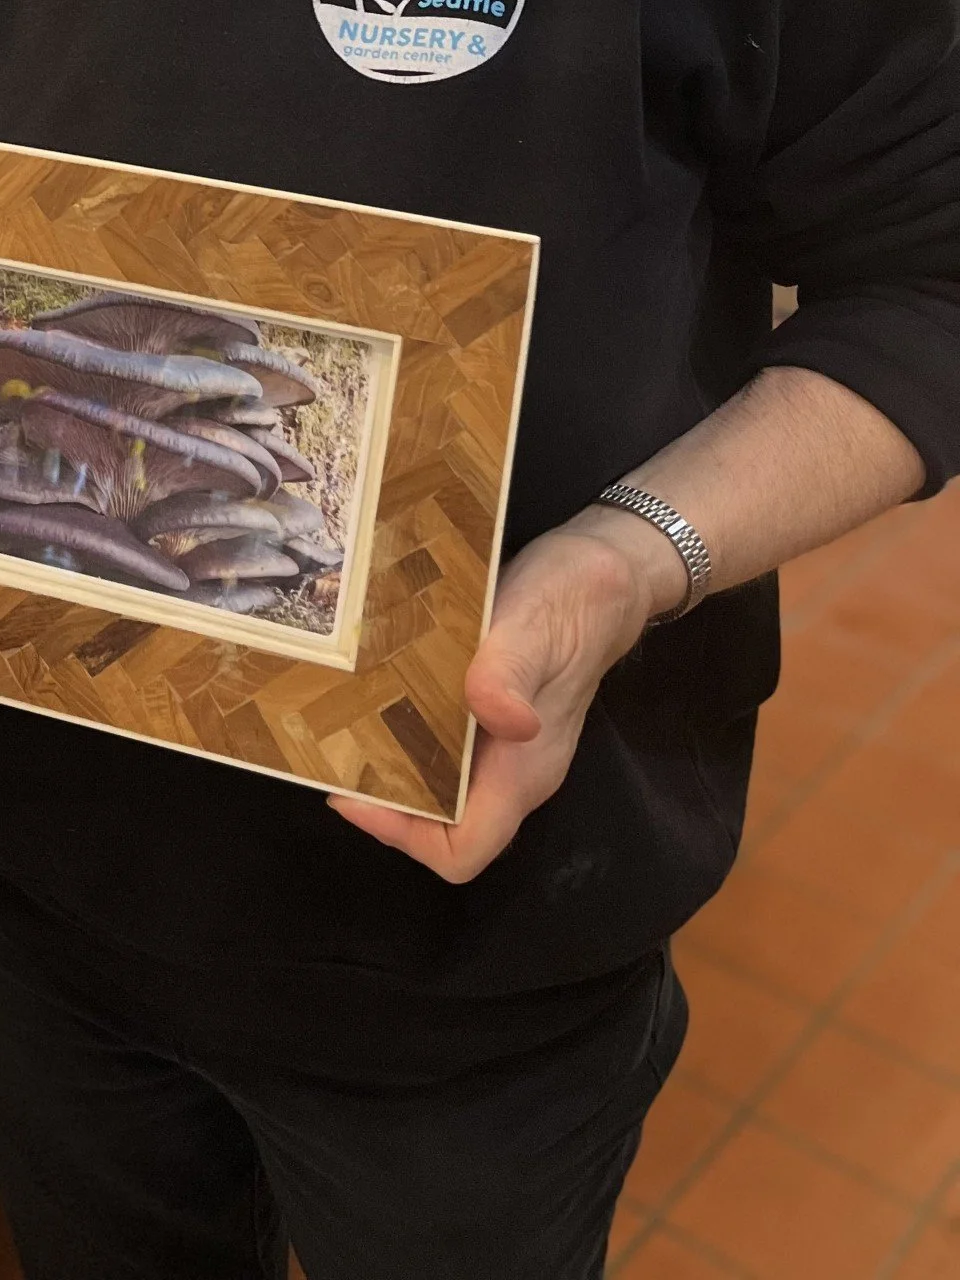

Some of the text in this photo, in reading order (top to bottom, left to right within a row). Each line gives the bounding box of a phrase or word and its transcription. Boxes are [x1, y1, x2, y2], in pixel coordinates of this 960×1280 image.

[339, 20, 487, 57] NURSERY &
[343, 45, 452, 63] garden center
